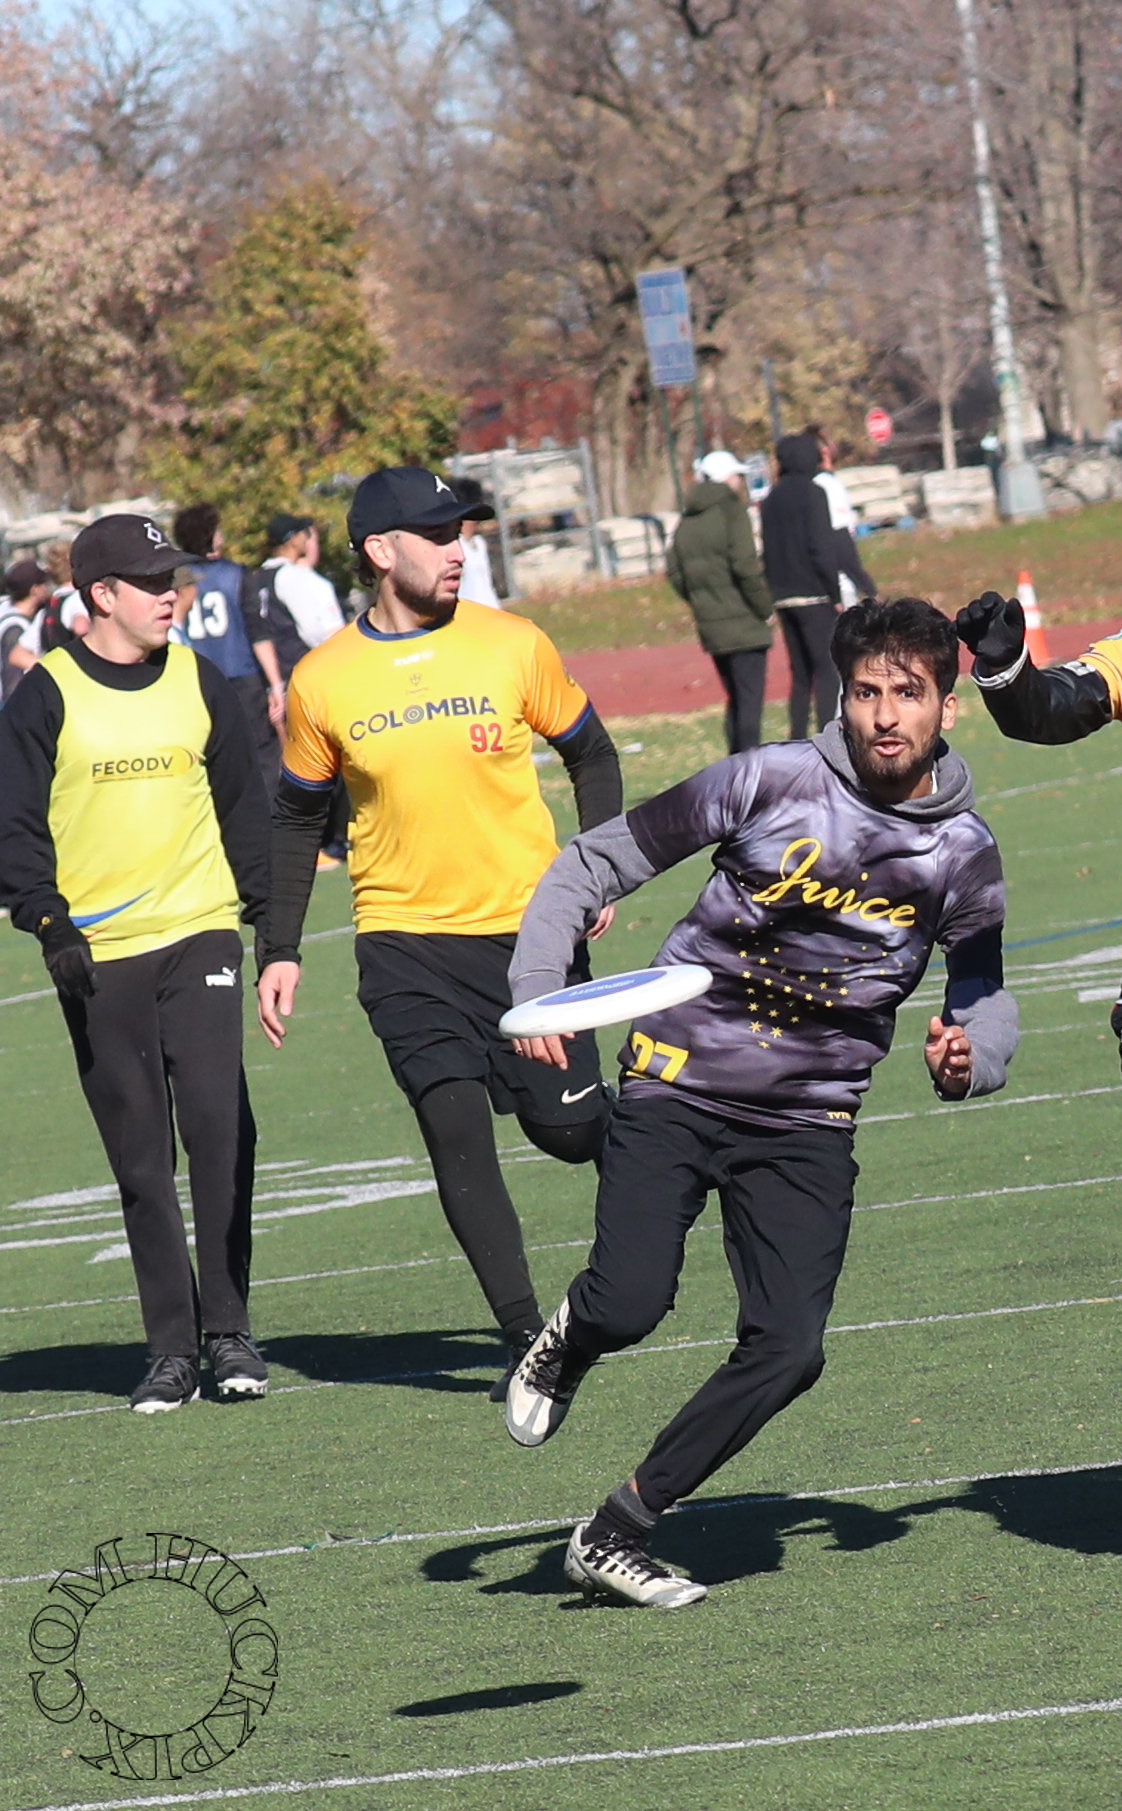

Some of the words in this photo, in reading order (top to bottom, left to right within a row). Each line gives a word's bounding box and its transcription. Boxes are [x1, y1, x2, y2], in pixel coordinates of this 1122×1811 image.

[349, 696, 497, 741] COLOMBIA
[469, 722, 504, 753] 92
[92, 757, 174, 777] FECODV
[751, 837, 915, 927] Juice
